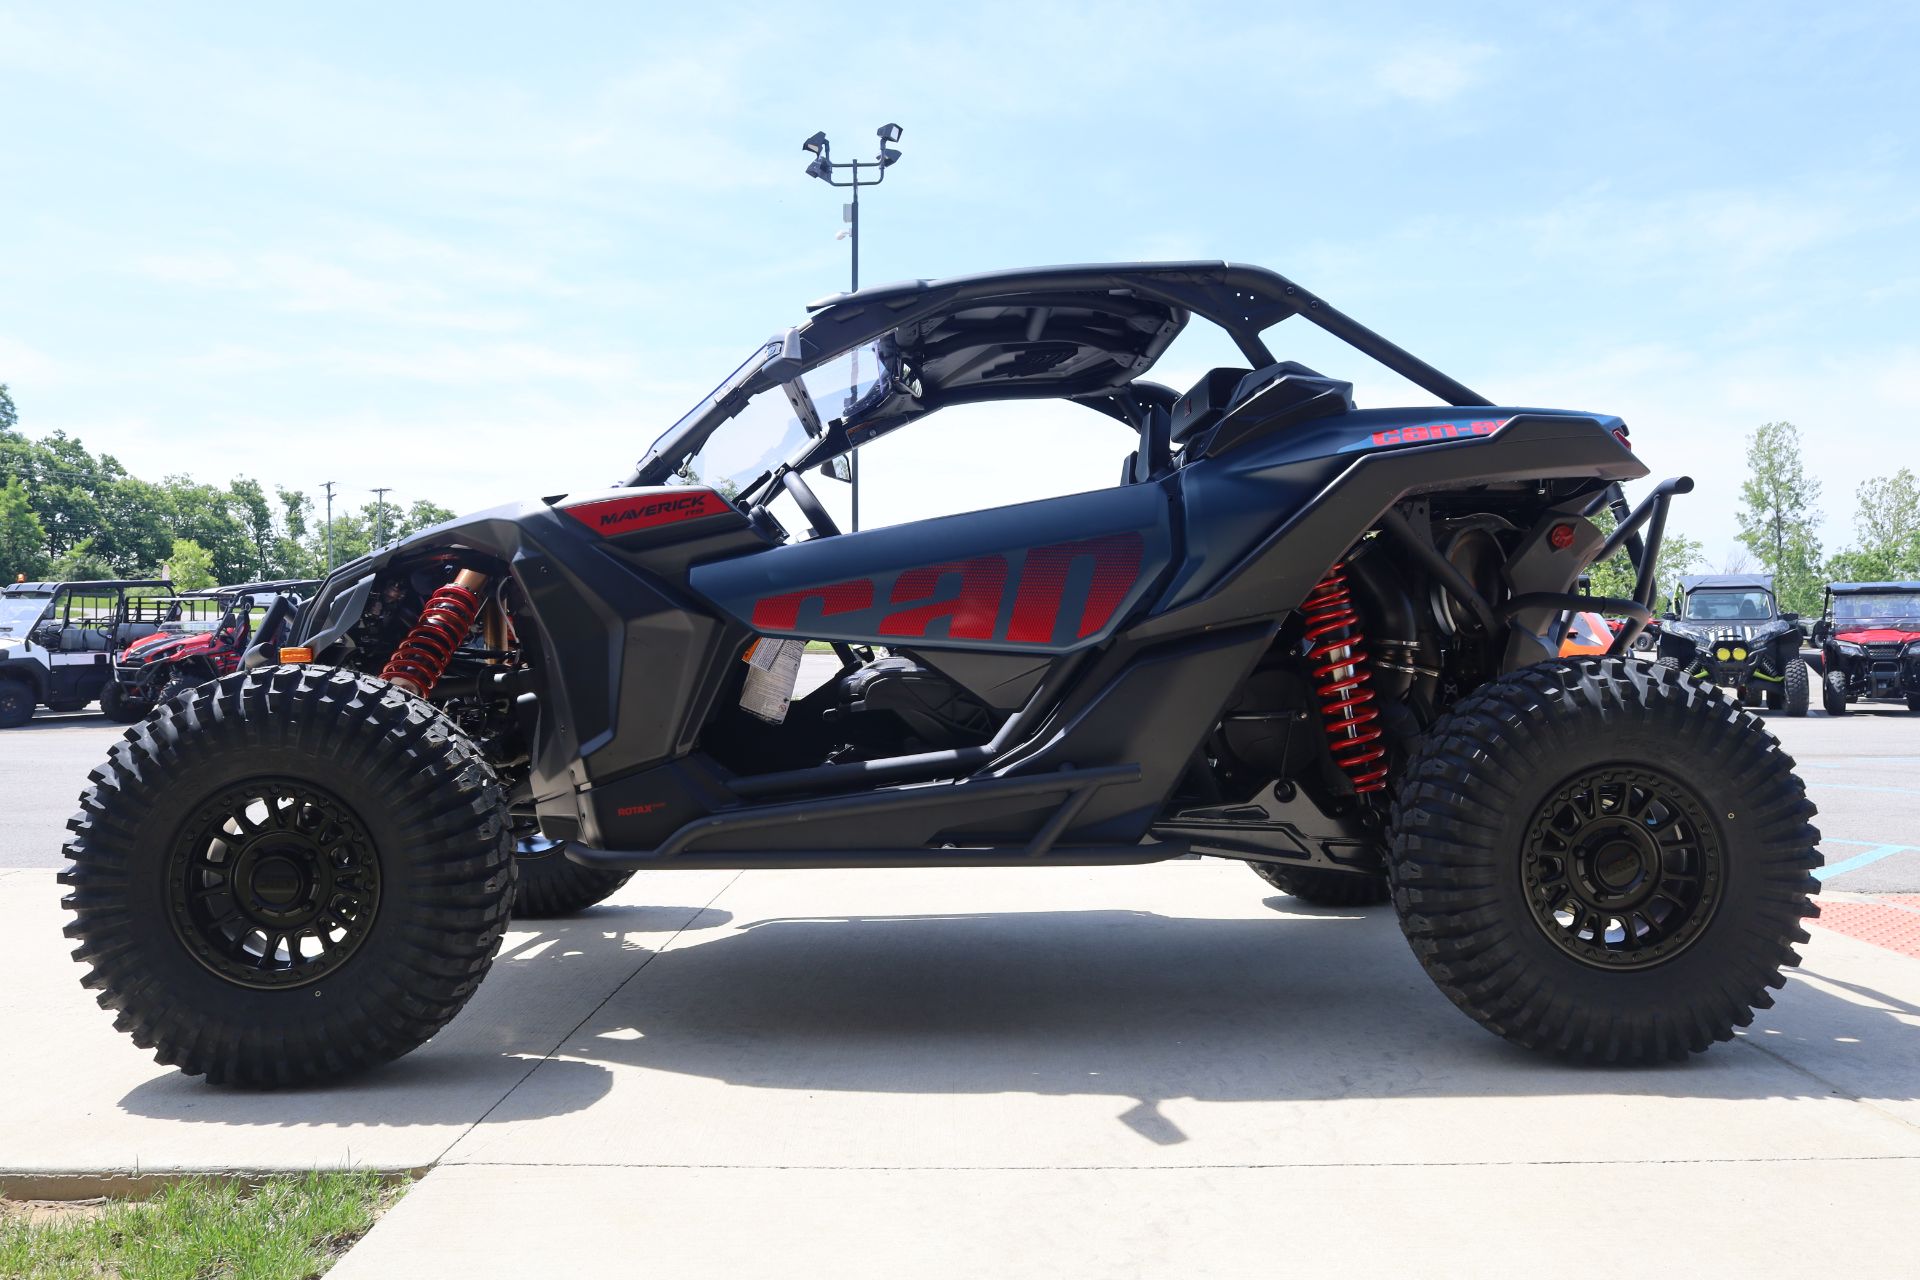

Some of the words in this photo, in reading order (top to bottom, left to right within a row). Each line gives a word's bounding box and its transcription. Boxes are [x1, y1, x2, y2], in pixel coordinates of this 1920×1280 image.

[1371, 419, 1509, 446] can-a
[600, 494, 707, 526] MAVERICK
[617, 804, 651, 816] ROTAX
